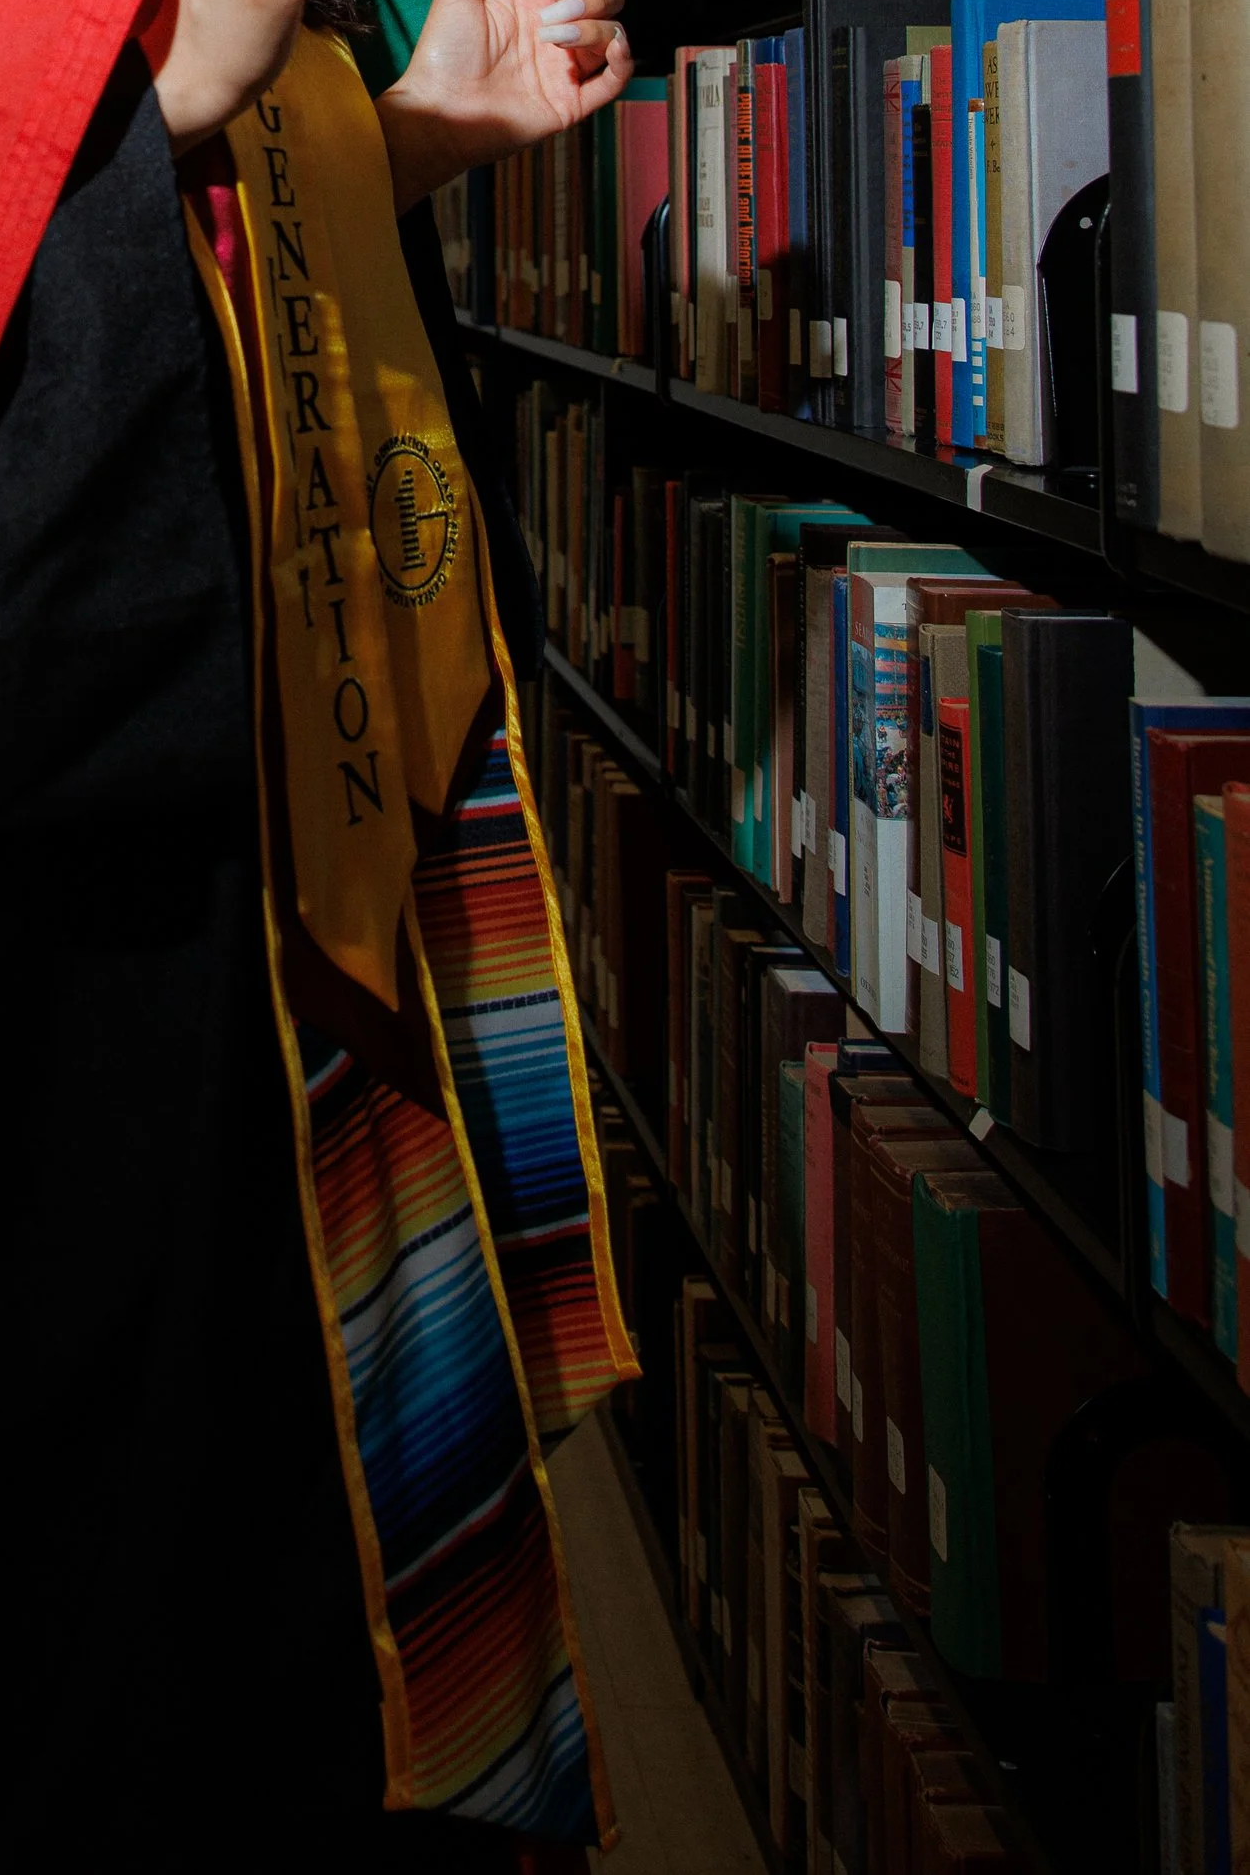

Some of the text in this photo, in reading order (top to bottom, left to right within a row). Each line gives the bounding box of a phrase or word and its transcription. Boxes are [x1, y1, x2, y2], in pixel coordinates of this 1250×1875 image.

[738, 91, 752, 141] PRINCE
[738, 146, 753, 196] ALBERT
[738, 197, 753, 222] and
[255, 86, 384, 825] GENERATION
